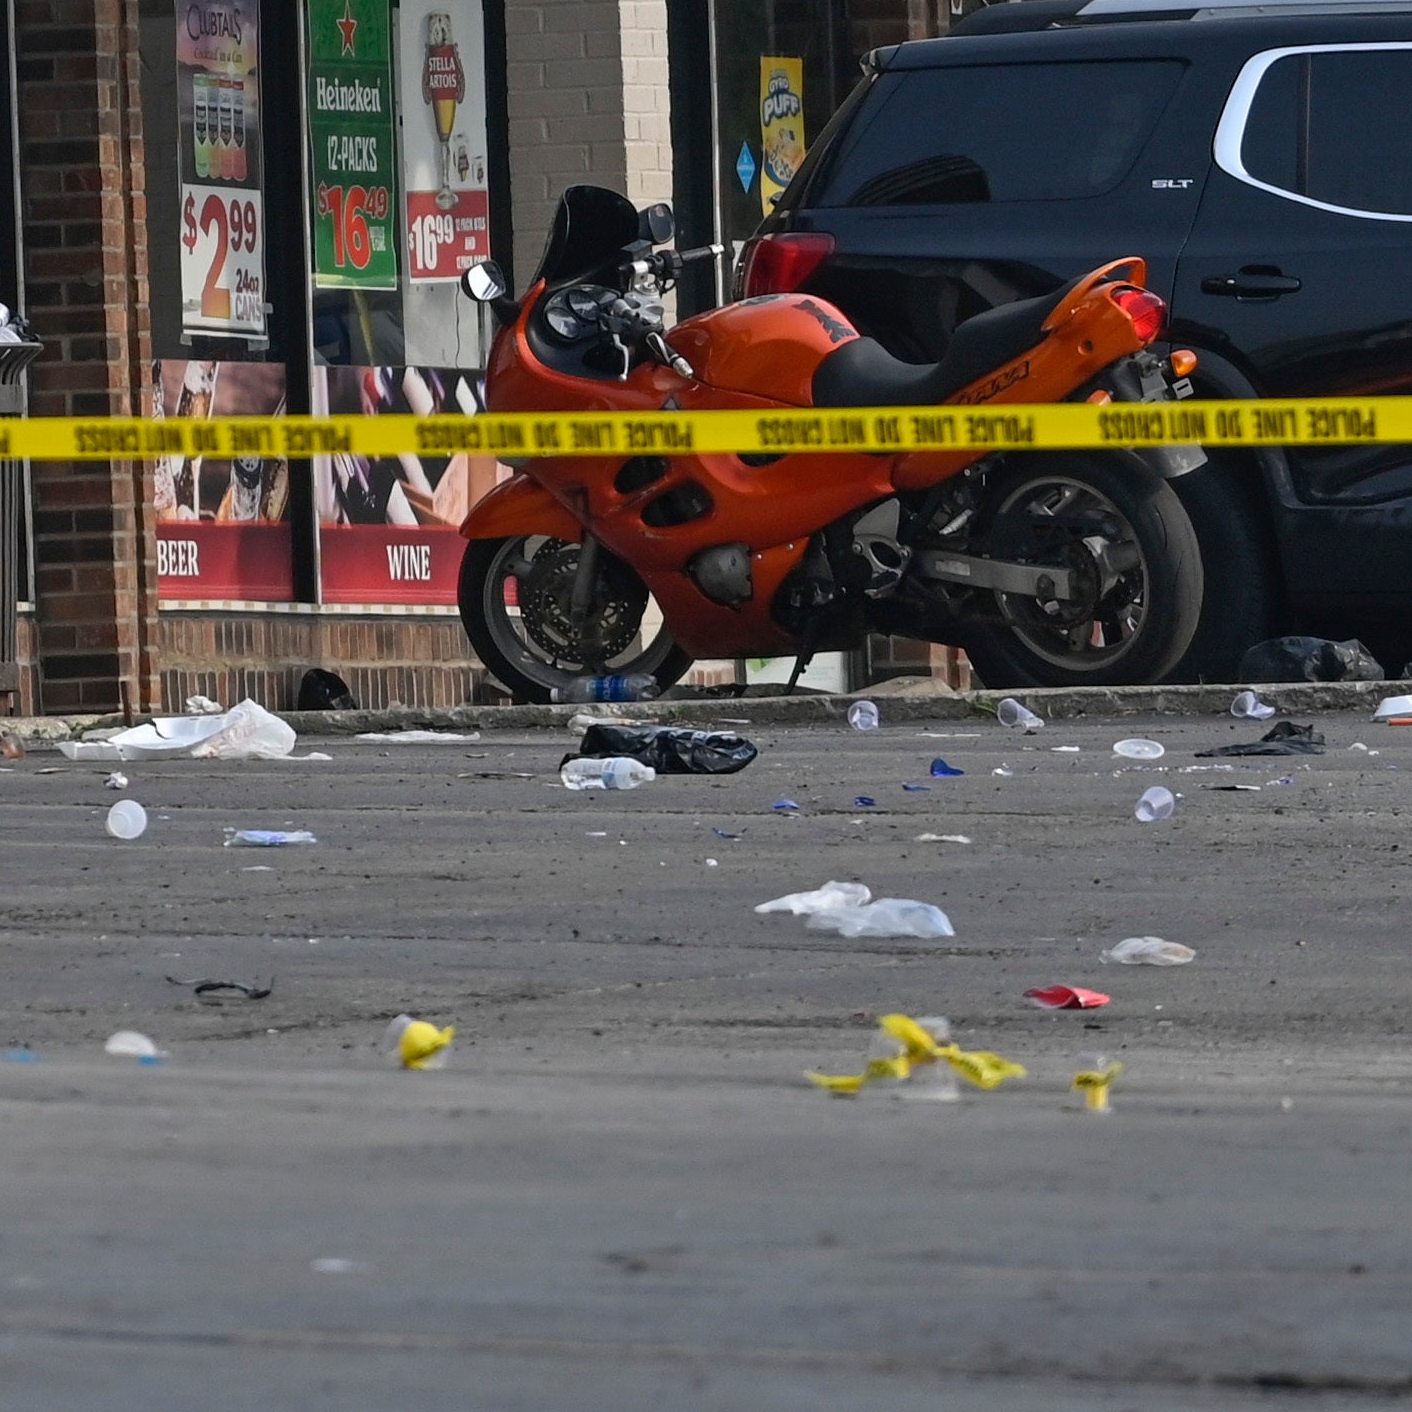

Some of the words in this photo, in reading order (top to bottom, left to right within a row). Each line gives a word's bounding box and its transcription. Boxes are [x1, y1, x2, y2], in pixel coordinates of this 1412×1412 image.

[428, 56, 456, 72] STELLA
[316, 77, 381, 113] Heineken
[428, 74, 457, 89] ARTOIS
[327, 135, 378, 172] 12-PACKS
[1151, 179, 1194, 188] SLT
[235, 295, 262, 322] CANS
[1097, 410, 1164, 440] CROSS
[1168, 409, 1206, 440] NOT
[1215, 408, 1242, 439] DO
[1250, 407, 1297, 438] LINE
[1305, 405, 1377, 438] POLICE
[157, 539, 200, 576] BEER
[387, 544, 431, 581] WINE
